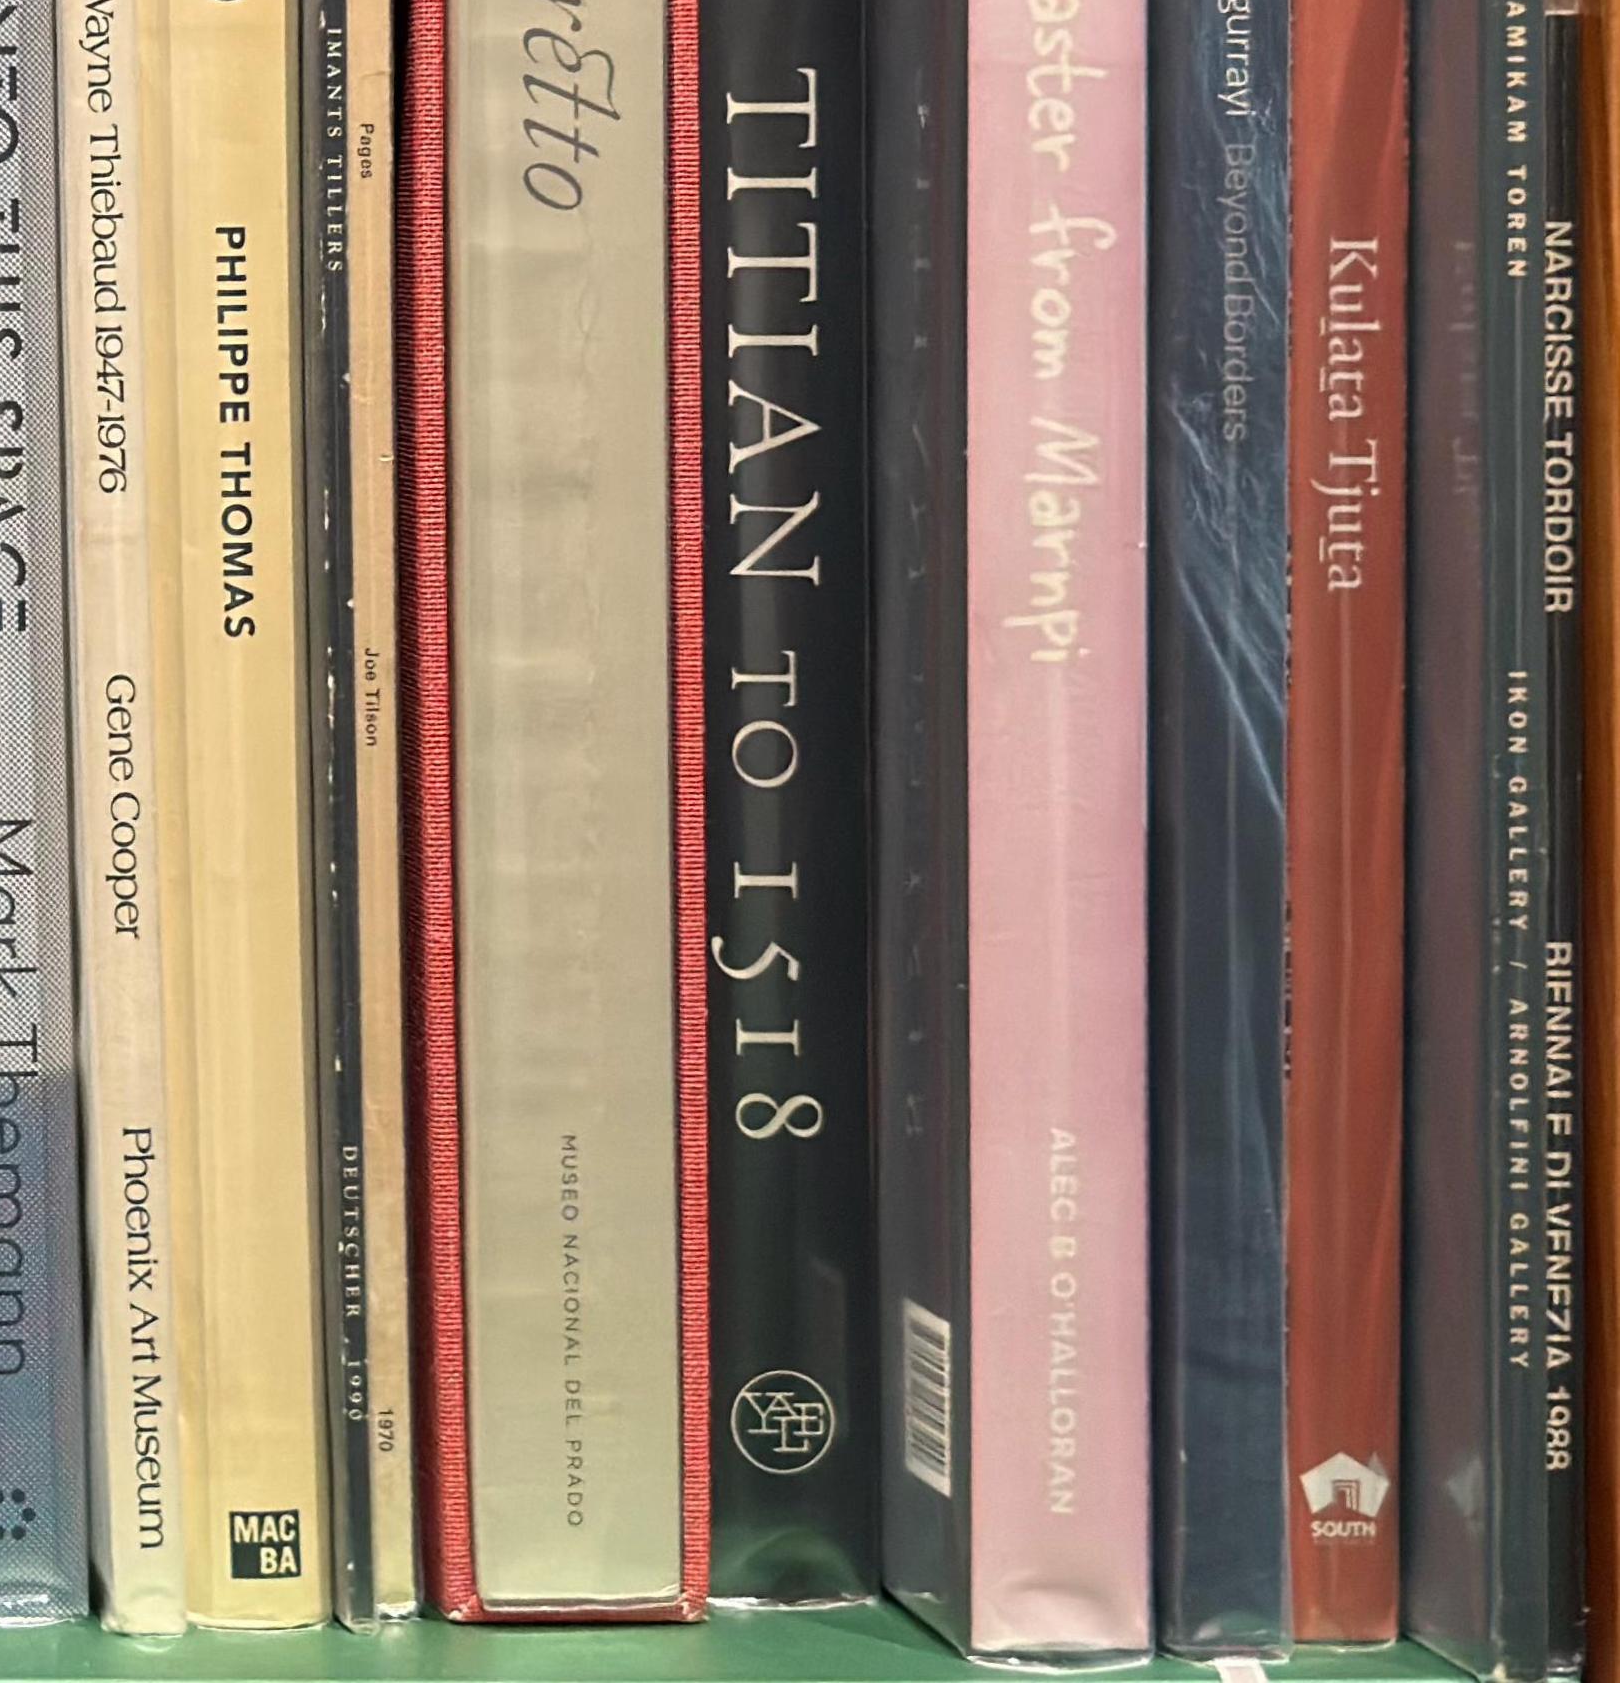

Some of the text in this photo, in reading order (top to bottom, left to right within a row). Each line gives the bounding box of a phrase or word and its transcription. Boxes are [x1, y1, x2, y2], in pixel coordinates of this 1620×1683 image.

[85, 123, 126, 315] Thiebaud
[323, 27, 343, 273] IMANTS TILLERS
[355, 122, 375, 180] Pages
[1214, 142, 1256, 284] Beyond
[1505, 0, 1528, 279] AMIKAM TOREN
[93, 324, 128, 493] 1947-1976
[723, 66, 822, 587] TITIAN
[1025, 200, 1118, 381] from
[1220, 293, 1254, 443] Borders
[214, 226, 255, 639] PHILIPPE THOMAS
[1000, 416, 1101, 664] Marnpi
[1541, 220, 1574, 614] NARCISSE TORDOIR
[362, 647, 379, 747] Joe Tilson
[728, 649, 800, 789] TO
[1506, 670, 1529, 1370] IKON GALLERY ARNOLFINI GALLERY
[119, 1126, 165, 1549] Phoenix Art Museum
[339, 1145, 362, 1422] DEUTSCHER 1990
[559, 1134, 583, 1527] MUSEO NACIONAL PRADO
[1045, 1127, 1075, 1515] ALEC O'HALLORAN
[376, 1407, 393, 1453] 1970
[1310, 1520, 1377, 1537] SOUTH
